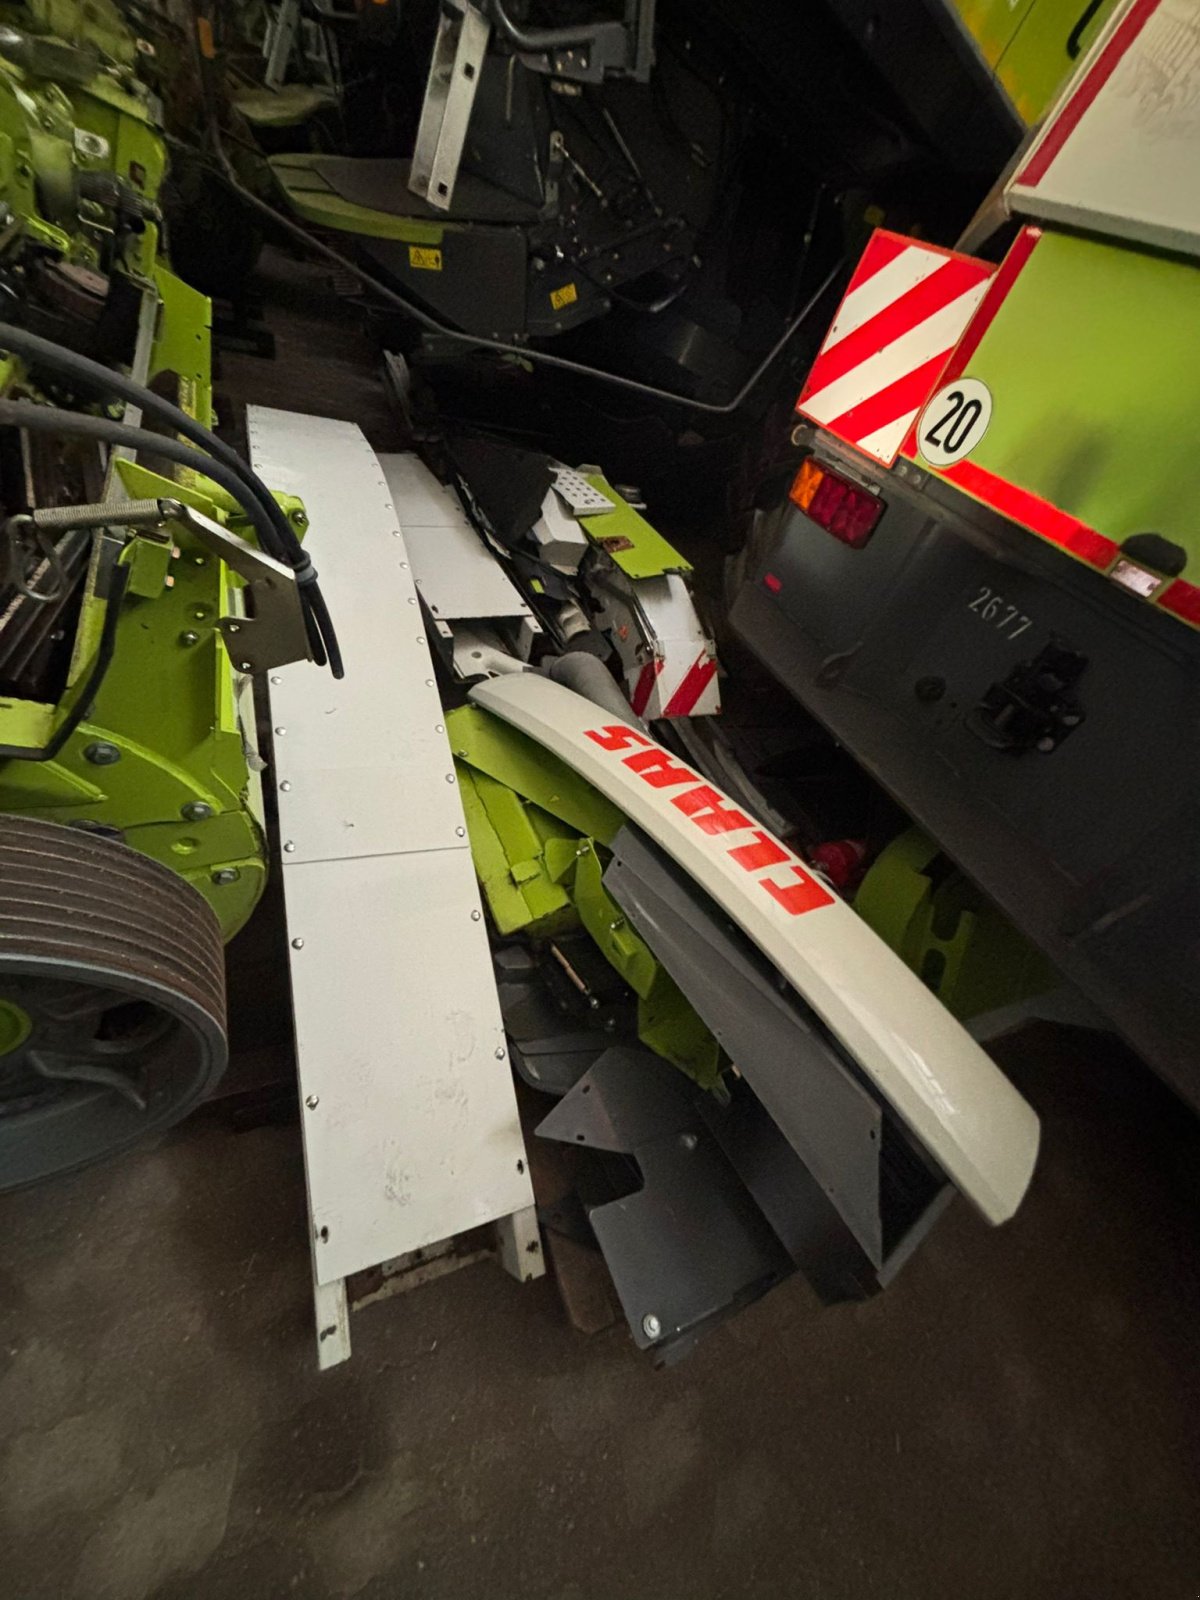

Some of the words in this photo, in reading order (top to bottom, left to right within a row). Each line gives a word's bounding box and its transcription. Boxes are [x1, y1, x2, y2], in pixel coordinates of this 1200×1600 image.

[924, 390, 983, 454] 20
[967, 586, 1033, 640] 2677
[583, 724, 836, 916] CLAAS
